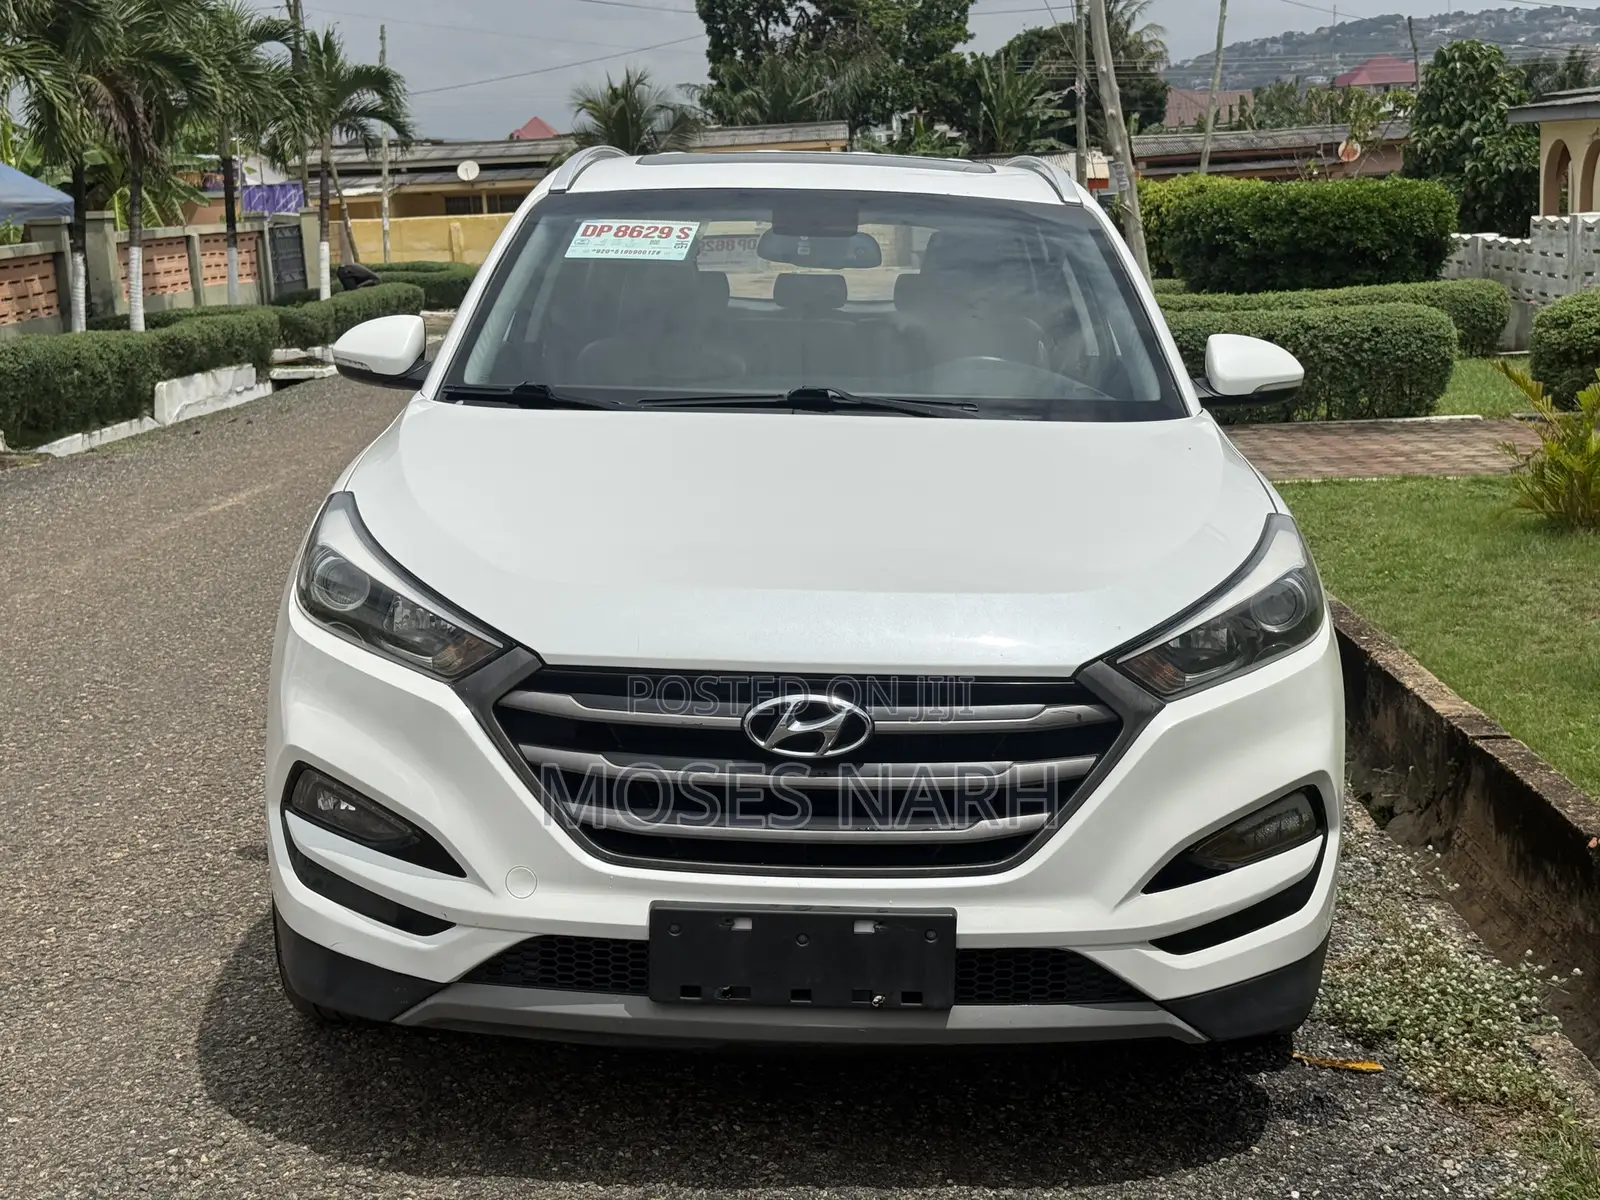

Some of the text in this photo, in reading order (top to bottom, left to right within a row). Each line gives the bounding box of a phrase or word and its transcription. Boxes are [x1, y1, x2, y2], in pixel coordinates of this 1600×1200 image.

[580, 225, 692, 239] DP 8629 S
